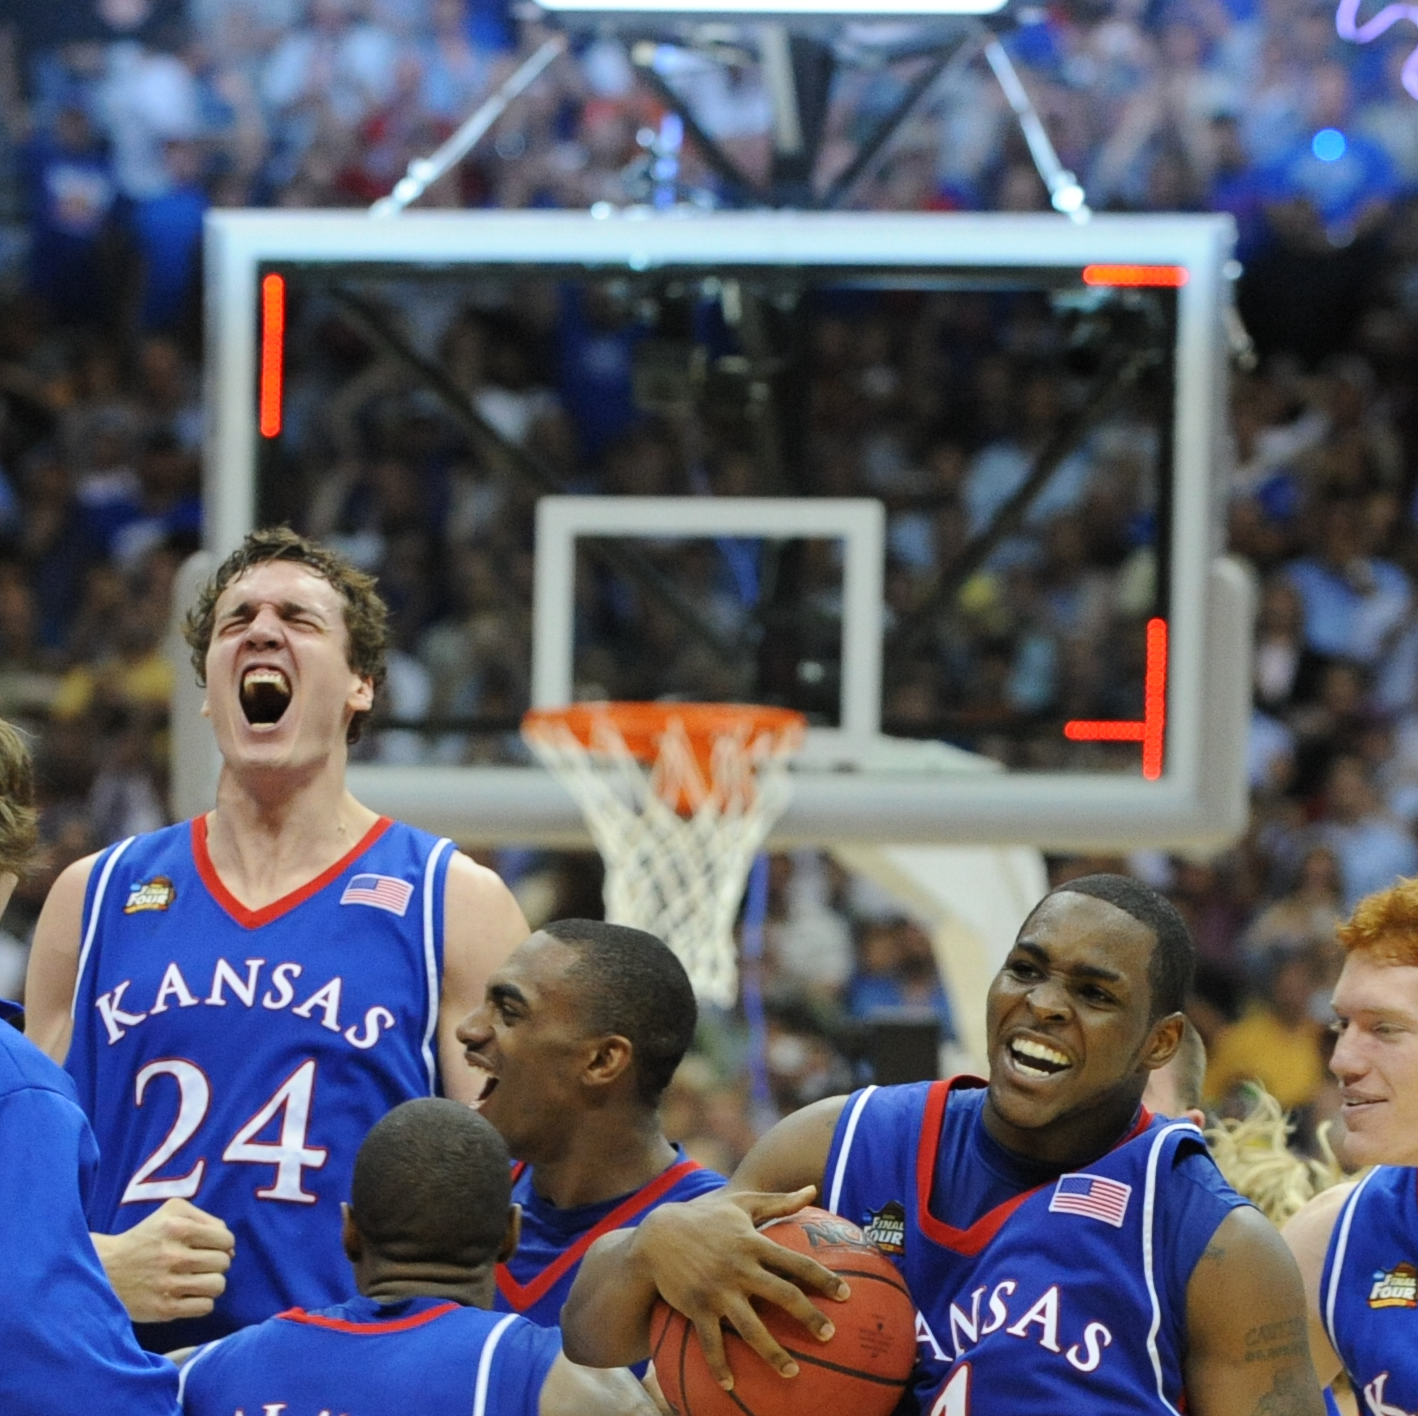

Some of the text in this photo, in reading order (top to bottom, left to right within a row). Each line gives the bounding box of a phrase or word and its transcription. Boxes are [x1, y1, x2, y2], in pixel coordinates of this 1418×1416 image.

[95, 957, 395, 1049] KANSAS
[121, 1057, 328, 1205] 24
[914, 1279, 1111, 1373] ANSAS
[1369, 1282, 1417, 1300] FOUR
